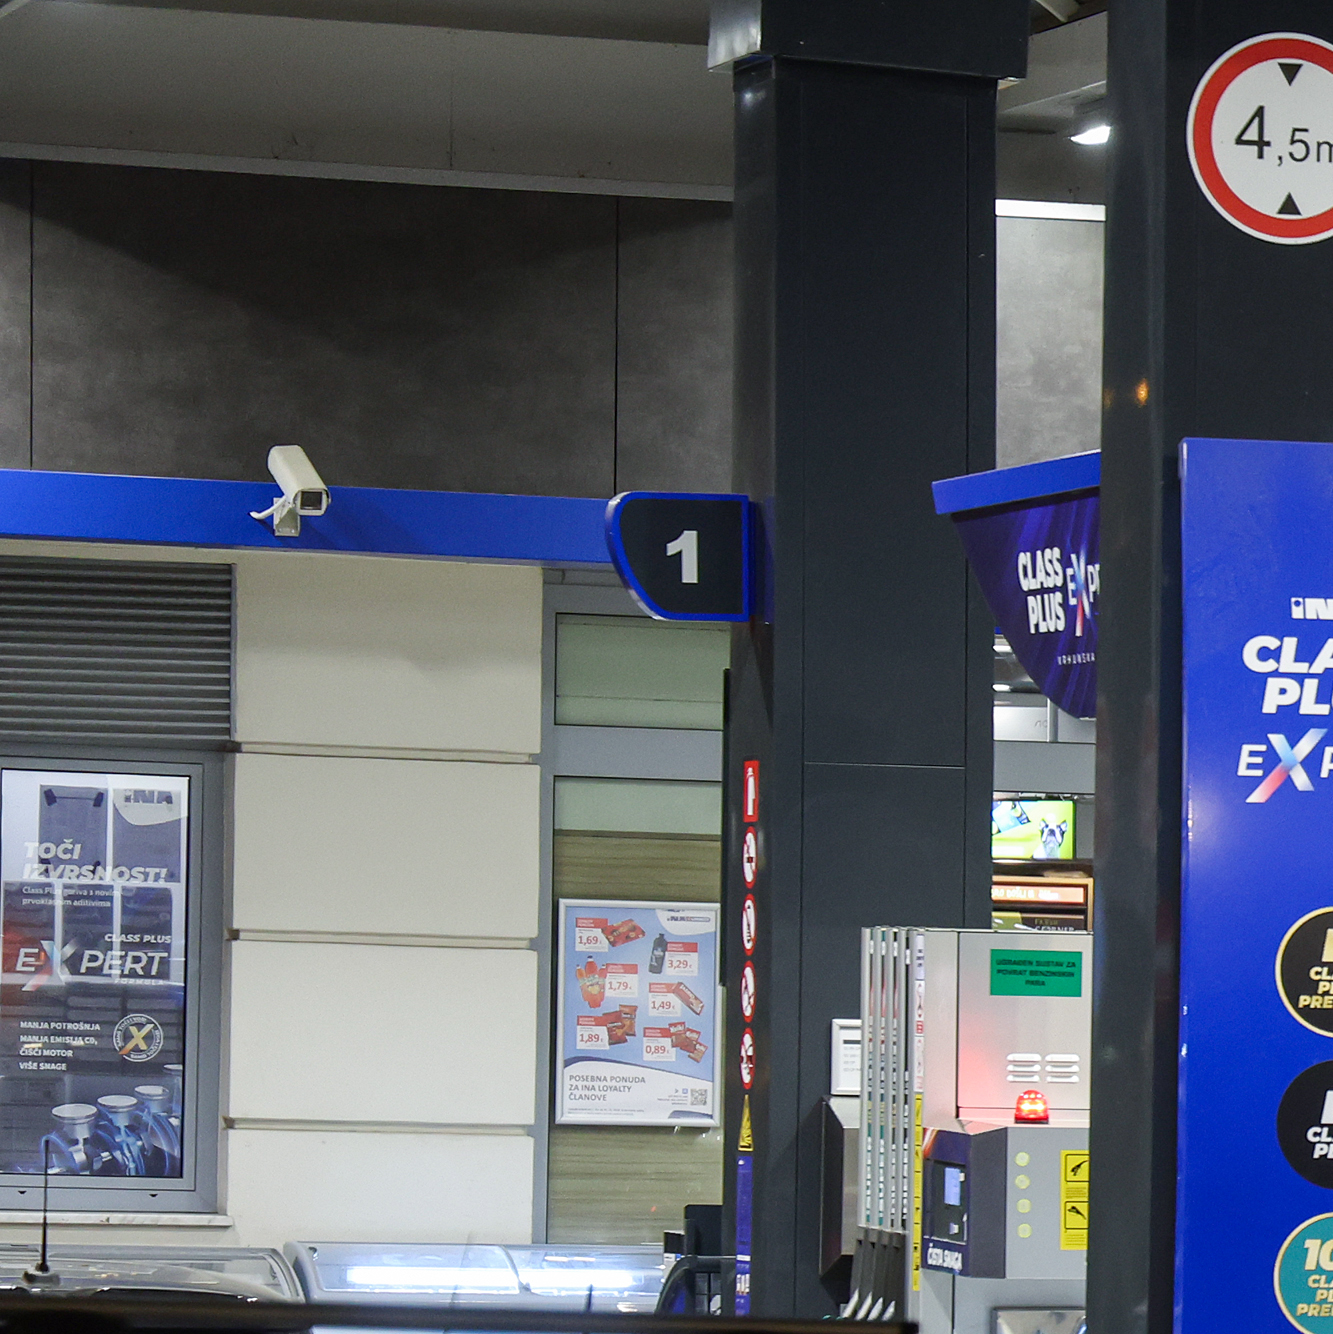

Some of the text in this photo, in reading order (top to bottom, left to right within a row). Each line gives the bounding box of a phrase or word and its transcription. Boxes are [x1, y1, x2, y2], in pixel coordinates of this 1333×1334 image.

[665, 529, 699, 584] 1
[1017, 546, 1064, 592] CLASS
[1026, 591, 1066, 635] PLUS
[24, 838, 82, 860] TOČI
[22, 863, 169, 884] IZVRSNOST!
[104, 933, 172, 944] CLASS PLUS
[578, 935, 599, 945] 1,69
[15, 938, 169, 992] EXPERT
[667, 959, 689, 969] 3,29
[607, 981, 629, 990] 1,79
[651, 1001, 671, 1010] 1,49
[20, 1021, 101, 1031] MANJA POTROŠNJA
[20, 1035, 49, 1043] MANJA
[579, 1034, 600, 1043] 1,89
[43, 1050, 74, 1058] MOTOR
[645, 1045, 666, 1054] 0,89
[19, 1061, 67, 1071] VIŠE SNAGE
[569, 1074, 646, 1083] POSEBNA PONUDA
[581, 1084, 596, 1092] INA
[598, 1084, 632, 1093] LOYALTY
[568, 1093, 607, 1102] ČLANOVE
